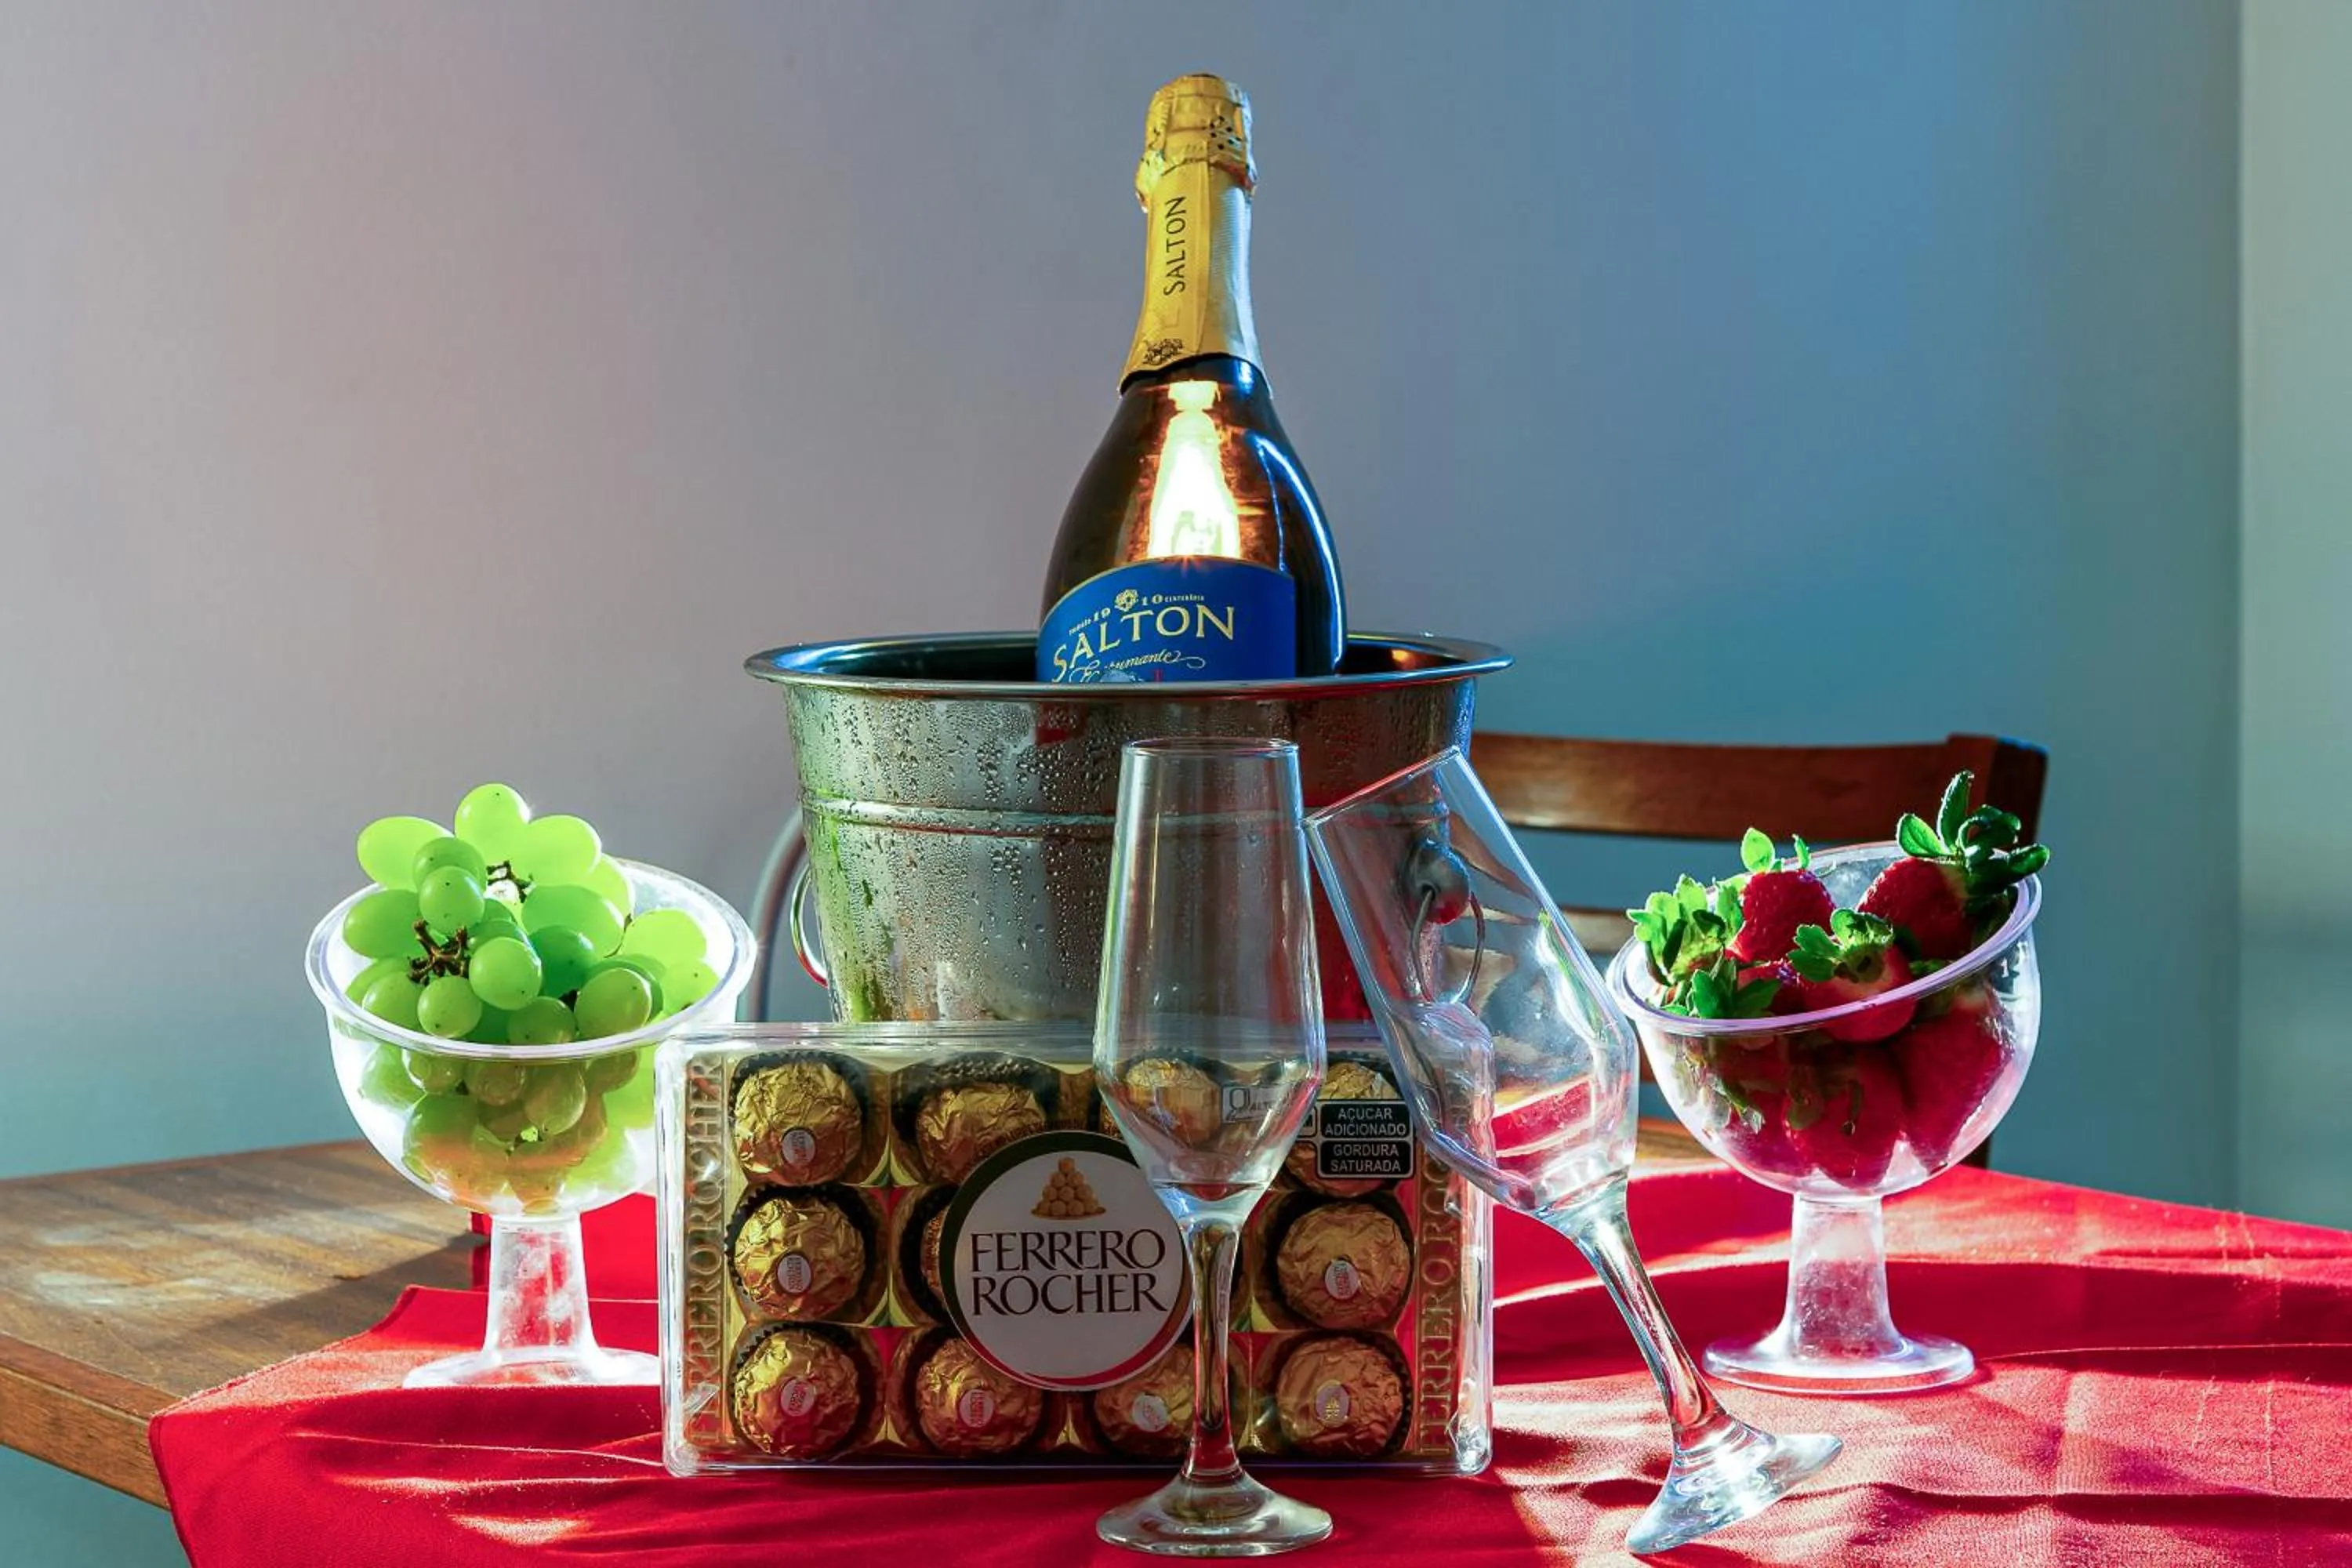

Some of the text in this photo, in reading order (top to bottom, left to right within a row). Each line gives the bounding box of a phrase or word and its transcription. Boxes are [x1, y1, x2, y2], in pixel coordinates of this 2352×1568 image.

[1163, 196, 1186, 296] SALTON
[1051, 604, 1235, 684] SALTON
[1324, 1123, 1406, 1137] ADICIONADO
[1333, 1143, 1399, 1157] GORDURA
[1330, 1159, 1402, 1173] SATURADA
[971, 1228, 1167, 1273] FERRERO
[972, 1272, 1168, 1316] ROCHER
[1420, 1258, 1455, 1454] FERRERO
